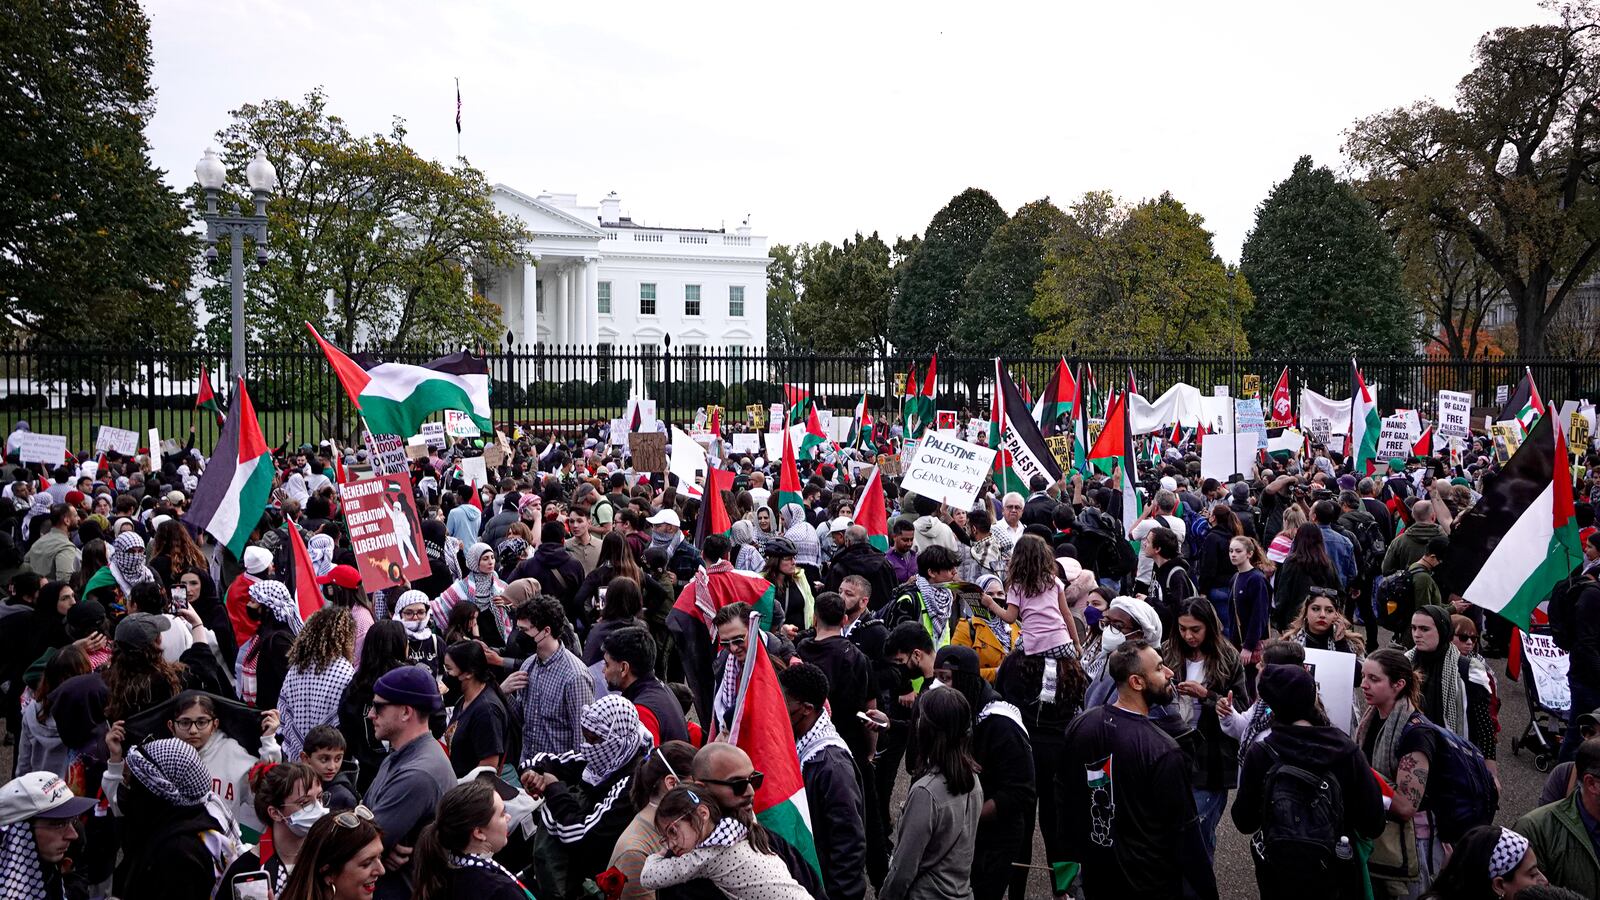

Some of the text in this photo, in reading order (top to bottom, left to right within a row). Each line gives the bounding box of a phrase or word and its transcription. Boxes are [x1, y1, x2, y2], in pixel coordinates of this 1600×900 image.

[1452, 404, 1467, 412] GAZA
[448, 411, 468, 421] FRE
[1446, 414, 1463, 424] FREE
[1386, 421, 1407, 430] HANDS
[1441, 423, 1468, 433] PALESTINE!
[103, 427, 131, 441] FREE
[1381, 430, 1409, 440] OFF GAZA
[1570, 426, 1588, 444] LIVE
[925, 435, 976, 460] PALESTINE
[1386, 441, 1403, 449] FREE
[1052, 446, 1067, 456] WAR
[386, 452, 405, 463] YOUR
[921, 454, 960, 471] OUTLIVE
[1008, 441, 1041, 477] PALEST
[912, 468, 958, 488] GENOCIDE
[343, 480, 384, 500] GENERATION
[345, 500, 361, 511] AFTER
[348, 507, 387, 526] GENERATION
[351, 523, 381, 537] UNTIL TOTAL
[354, 532, 398, 555] LIBERATION
[1535, 637, 1551, 648] THE
[1534, 648, 1557, 657] GAZA
